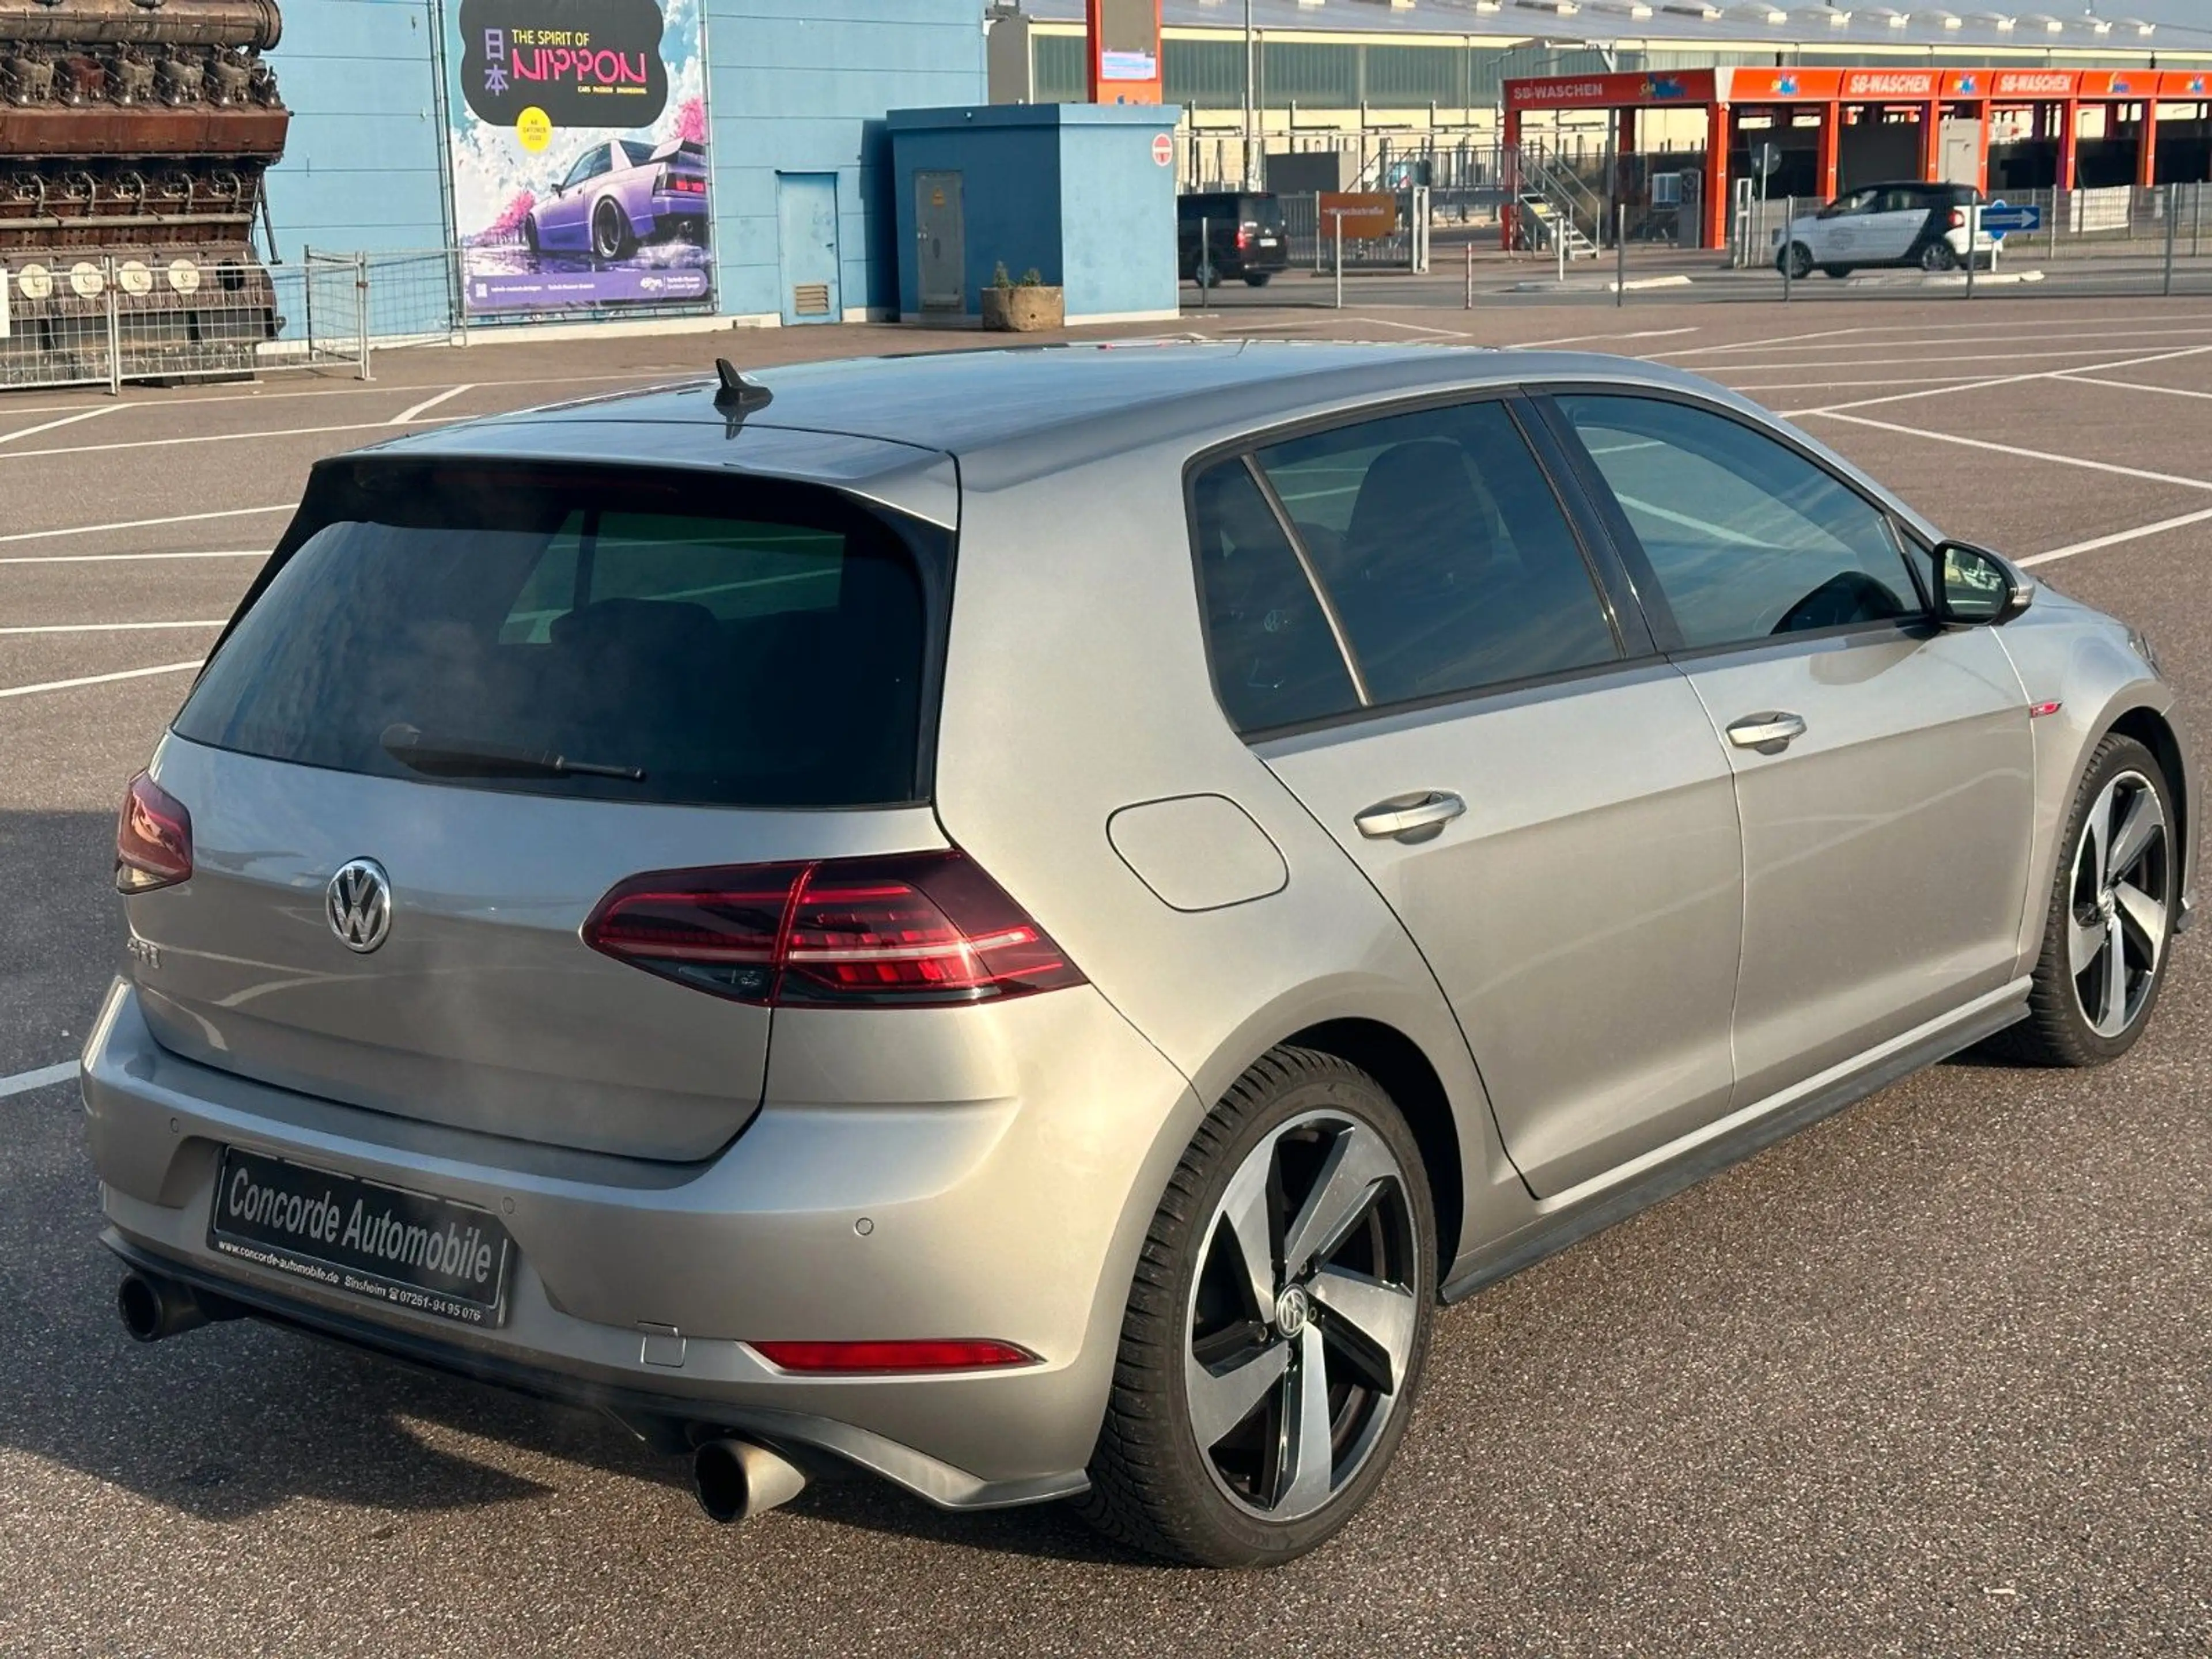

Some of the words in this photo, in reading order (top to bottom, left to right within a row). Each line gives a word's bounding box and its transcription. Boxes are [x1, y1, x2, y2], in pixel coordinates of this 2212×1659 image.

[512, 29, 535, 45] THE
[537, 31, 571, 46] SPIRIT
[575, 32, 590, 47] OF
[484, 29, 509, 97] 日本
[512, 48, 646, 84] NIPPON
[1514, 83, 1603, 100] SB-WASCHEN
[1850, 74, 1933, 93] SB-WASCHEN
[2000, 74, 2072, 93] SB-WASCHEN
[230, 1168, 340, 1243] Concorde
[341, 1198, 491, 1283] Automobile
[218, 1240, 339, 1284] www.concorde-automobile.de
[344, 1275, 386, 1297] Sinsheim
